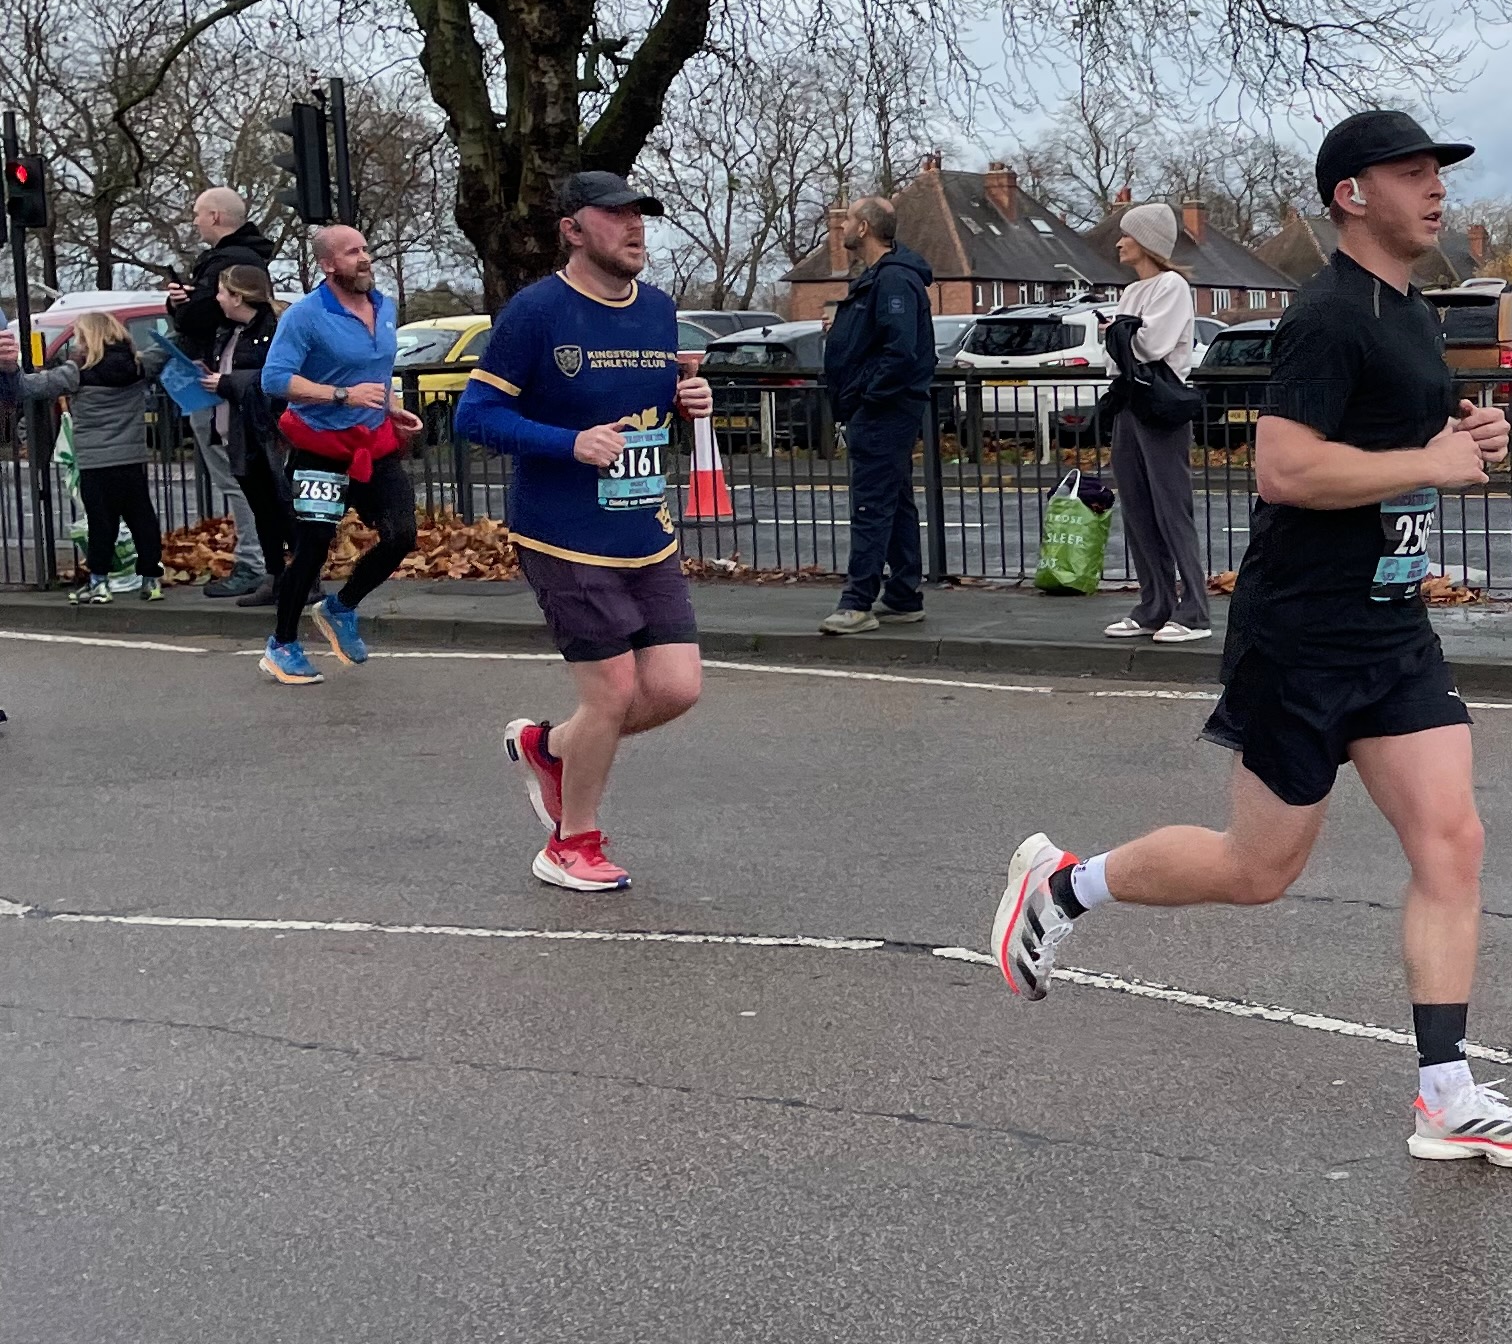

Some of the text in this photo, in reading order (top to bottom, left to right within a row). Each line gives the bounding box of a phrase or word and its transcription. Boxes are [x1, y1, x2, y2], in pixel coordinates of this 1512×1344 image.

[587, 350, 640, 360] KINGSTON
[590, 359, 666, 368] ATHLETIC CLUB
[609, 446, 661, 478] 3161
[299, 480, 341, 502] 2635
